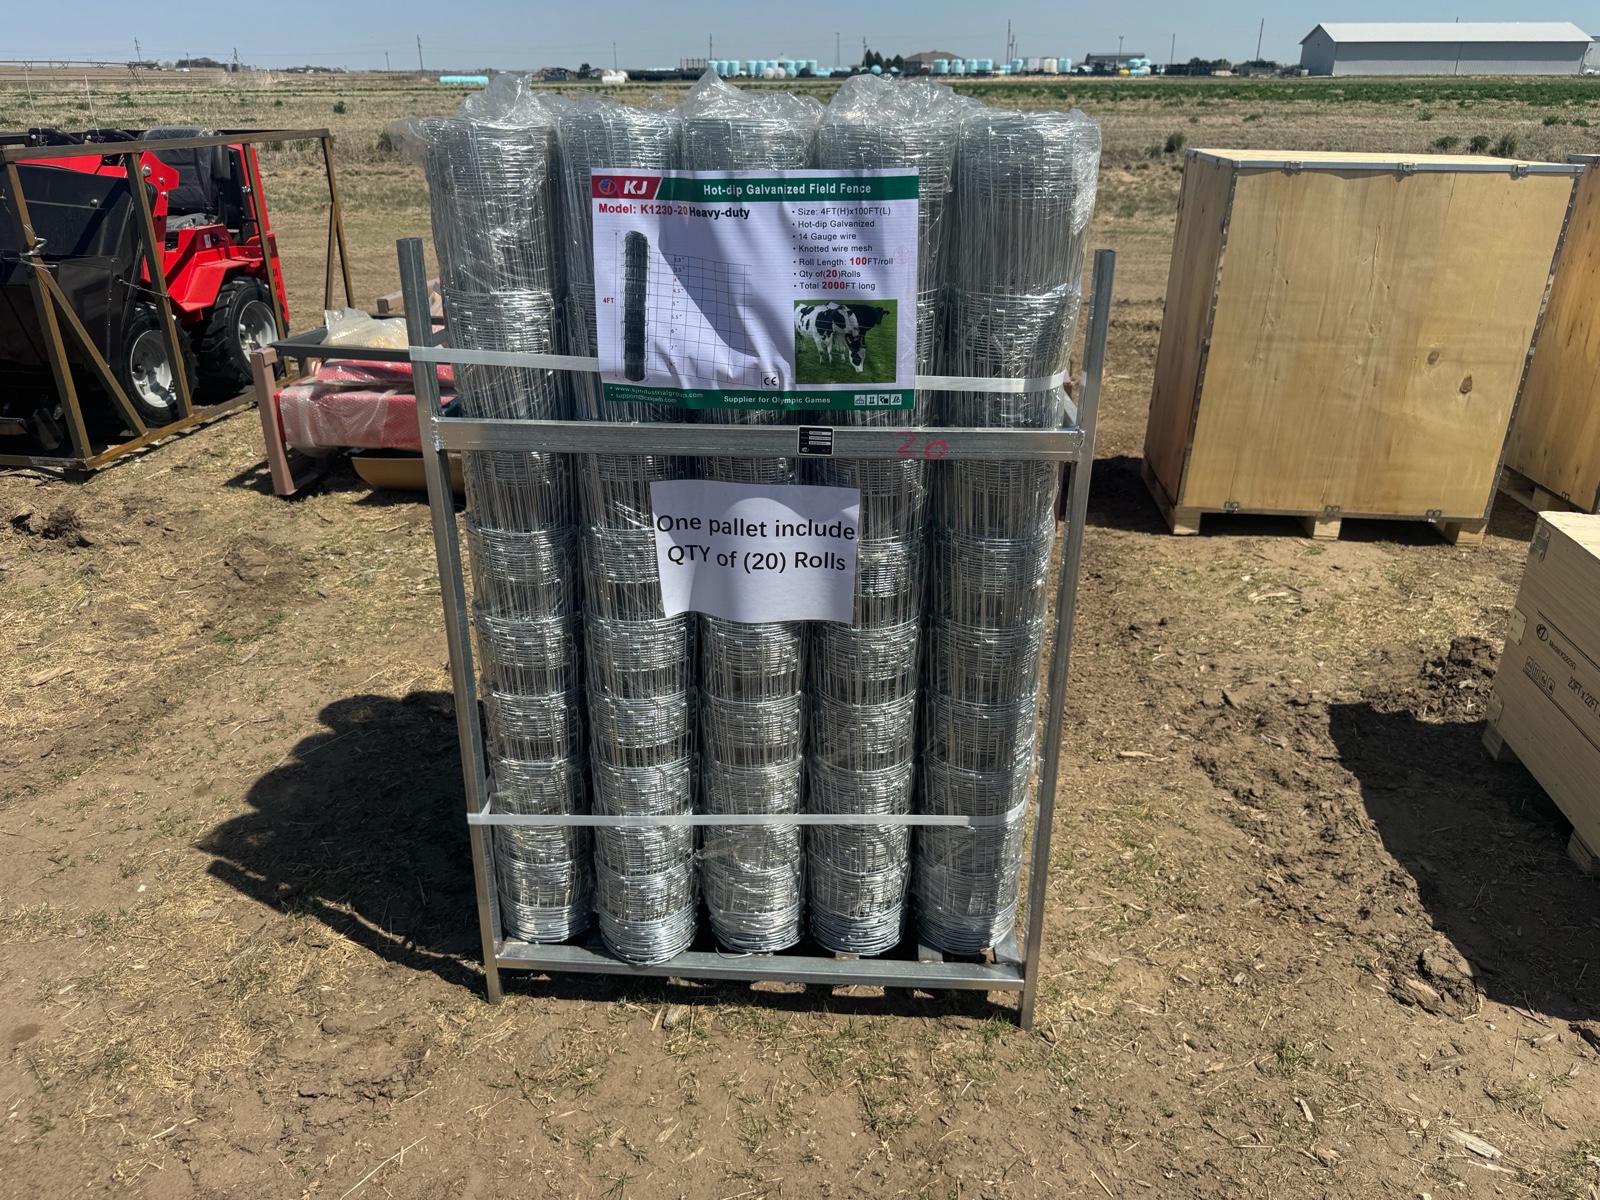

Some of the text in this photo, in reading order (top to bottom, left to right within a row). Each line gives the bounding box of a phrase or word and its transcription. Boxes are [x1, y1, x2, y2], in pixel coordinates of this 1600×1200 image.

[623, 180, 648, 195] KJ
[703, 182, 872, 197] Hot-dip Galvanized Field Fence
[598, 203, 750, 220] Model: K1230-20 Heavy-duty
[797, 206, 891, 217] Size: 4FT(H)x100FT(L)
[797, 219, 875, 230] Hot-dip Galvanized
[798, 232, 857, 242] 14 Gauge wire
[798, 244, 873, 253] Knotted wire mesh
[799, 256, 894, 268] Roll Length: 100FT/roll
[799, 269, 815, 279] Qty
[799, 281, 876, 291] Total 2000FT long
[763, 376, 778, 386] CE
[723, 395, 831, 405] Supplier for Olympic Games
[892, 430, 949, 459] 20
[656, 514, 856, 540] One pallet include
[667, 545, 846, 574] QTY of (20) Rolls
